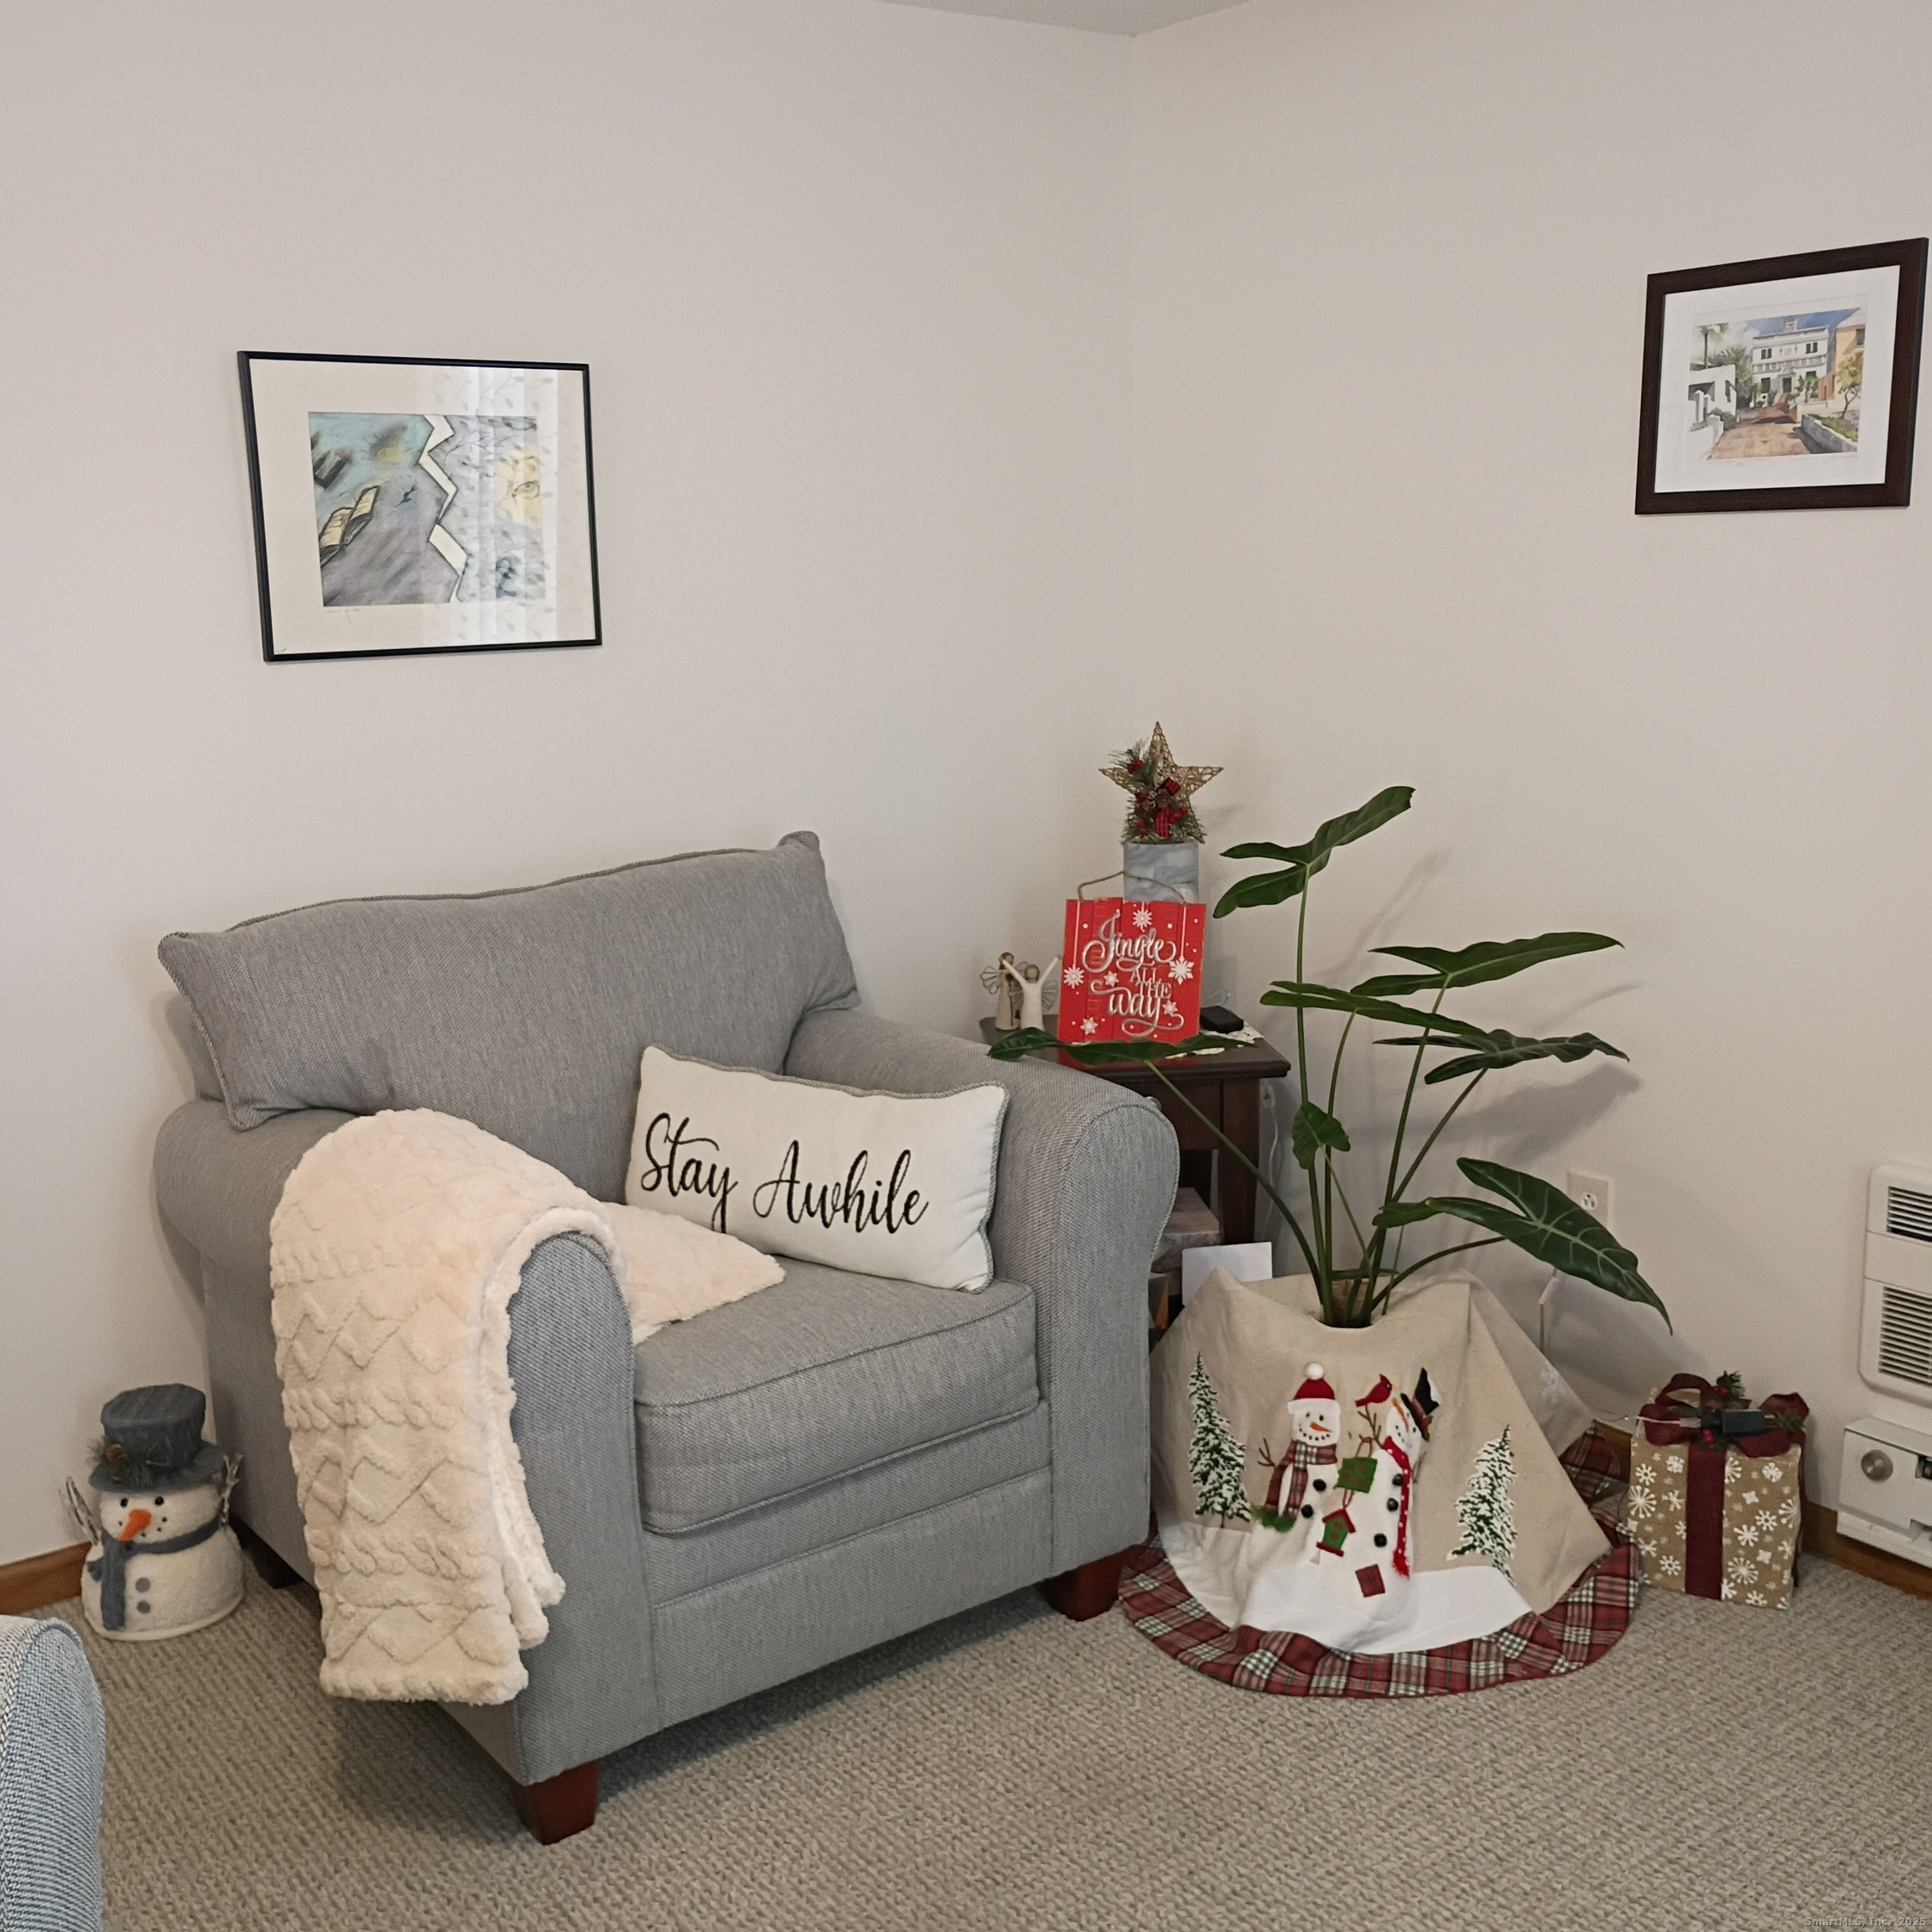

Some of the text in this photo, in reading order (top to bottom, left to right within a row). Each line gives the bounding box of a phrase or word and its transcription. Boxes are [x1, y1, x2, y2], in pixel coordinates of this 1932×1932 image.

[1081, 911, 1176, 974] Jingle
[1129, 967, 1157, 983] ALL
[1135, 978, 1171, 999] THE
[641, 1112, 929, 1233] Stay Awhile
